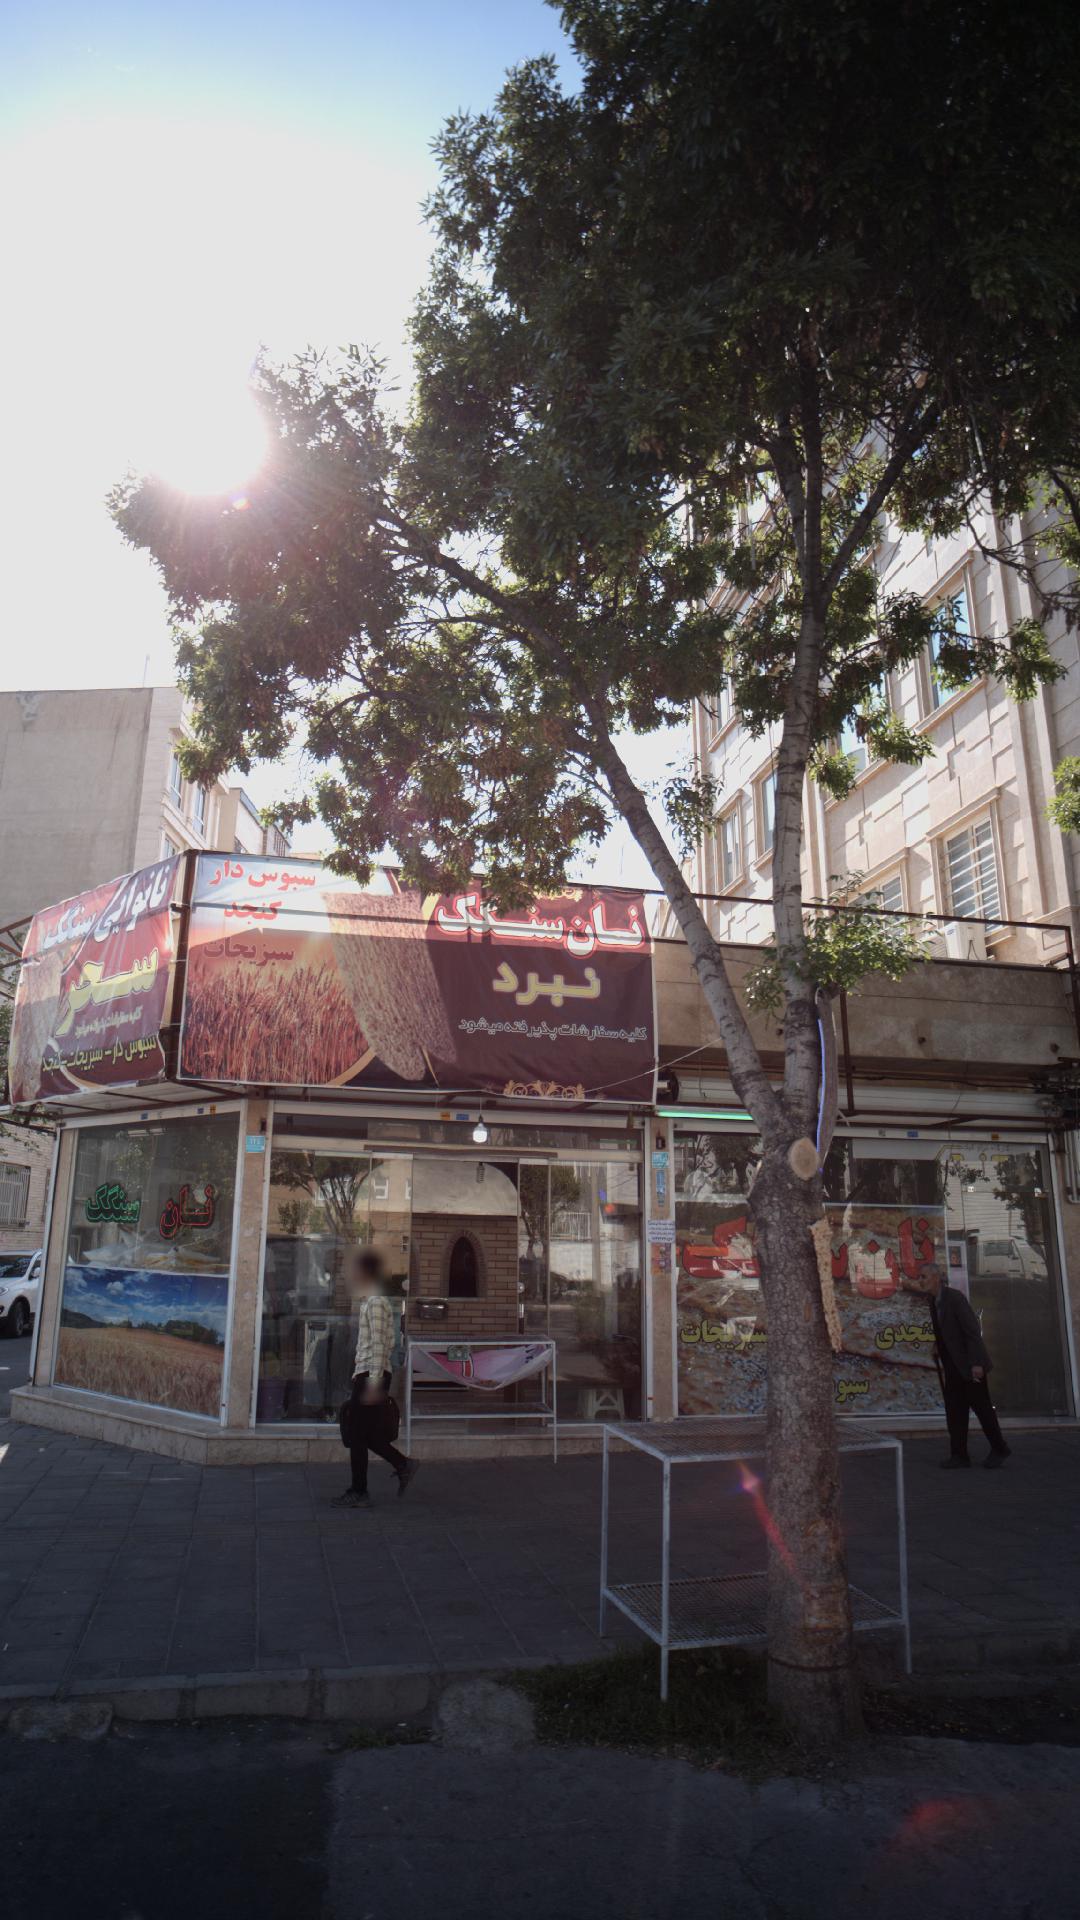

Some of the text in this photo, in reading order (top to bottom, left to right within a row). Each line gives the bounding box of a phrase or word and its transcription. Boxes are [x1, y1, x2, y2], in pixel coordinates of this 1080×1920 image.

[209, 859, 316, 891] سبوس دار
[224, 901, 282, 925] کنجد
[562, 900, 645, 958] نان
[204, 937, 294, 966] سبزیجات
[55, 947, 158, 1037] سحر
[492, 961, 601, 1007] نبرد
[125, 1034, 157, 1062] سبوس
[559, 1024, 619, 1041] سفارشات
[619, 1027, 647, 1043] کلیه
[87, 1184, 214, 1239] نان سنگک
[856, 1216, 936, 1299] نان
